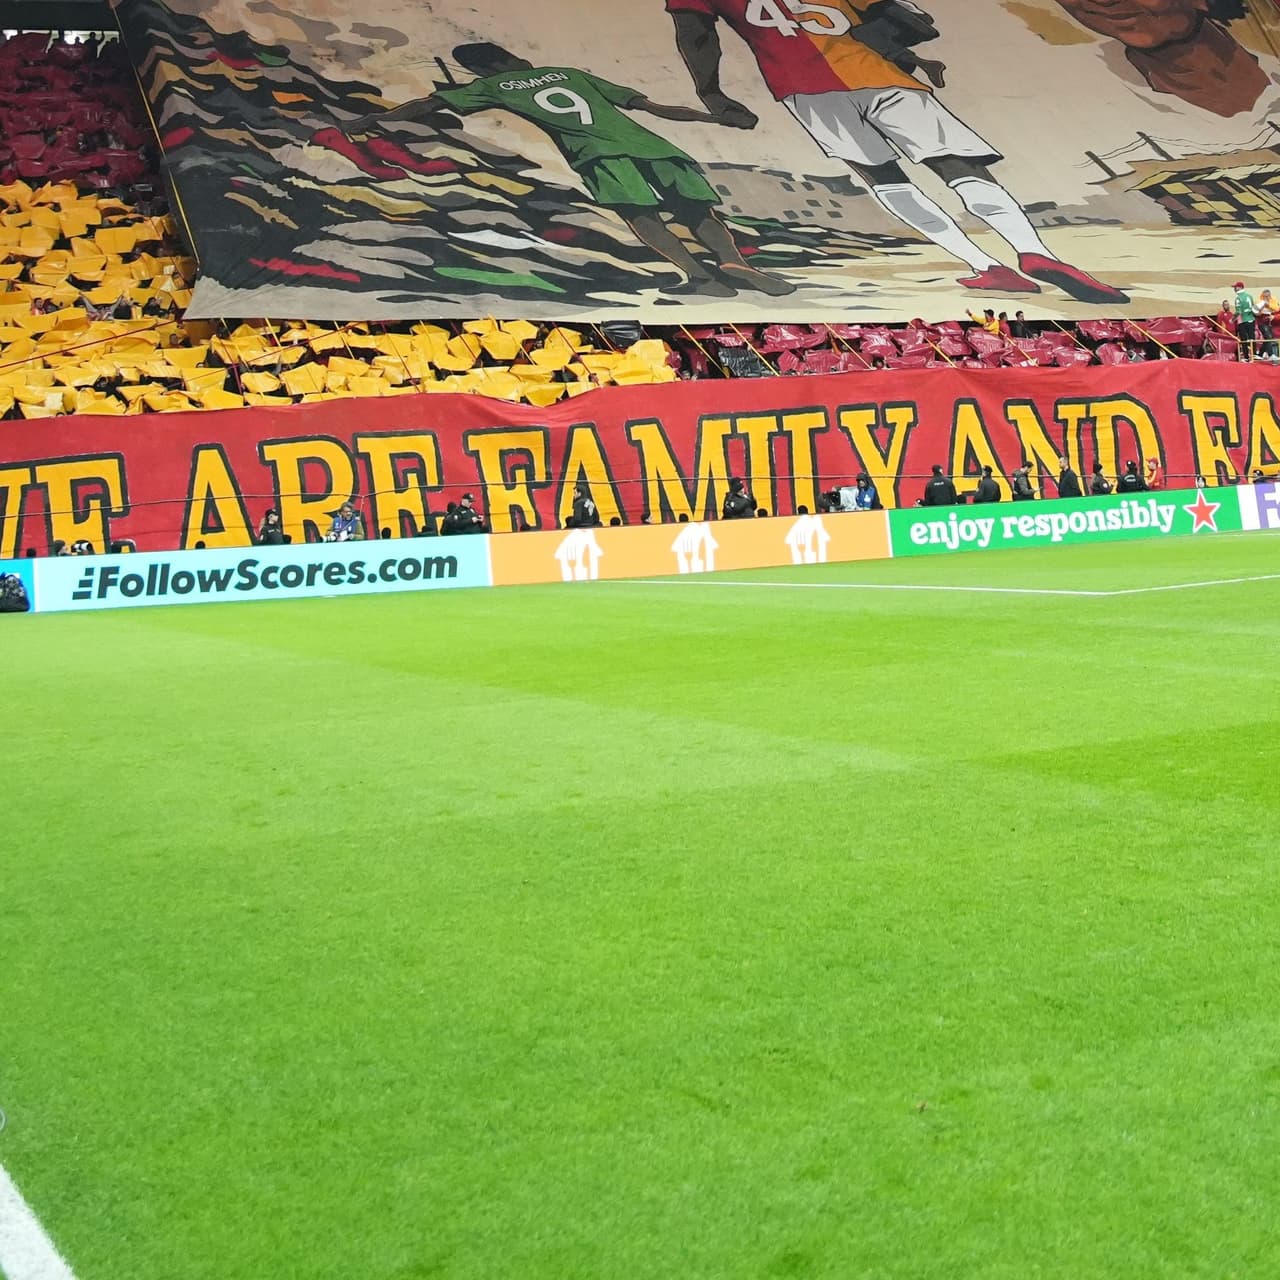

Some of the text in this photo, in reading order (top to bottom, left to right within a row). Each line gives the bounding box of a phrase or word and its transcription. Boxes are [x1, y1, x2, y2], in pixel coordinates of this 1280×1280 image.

[499, 72, 569, 91] OSIMHEN
[533, 86, 594, 125] 9
[179, 430, 448, 550] ARE
[464, 400, 917, 533] FAMILY
[946, 392, 1166, 504] AND
[910, 500, 1176, 549] enjoy responsibly
[96, 555, 458, 600] FollowScores.com
